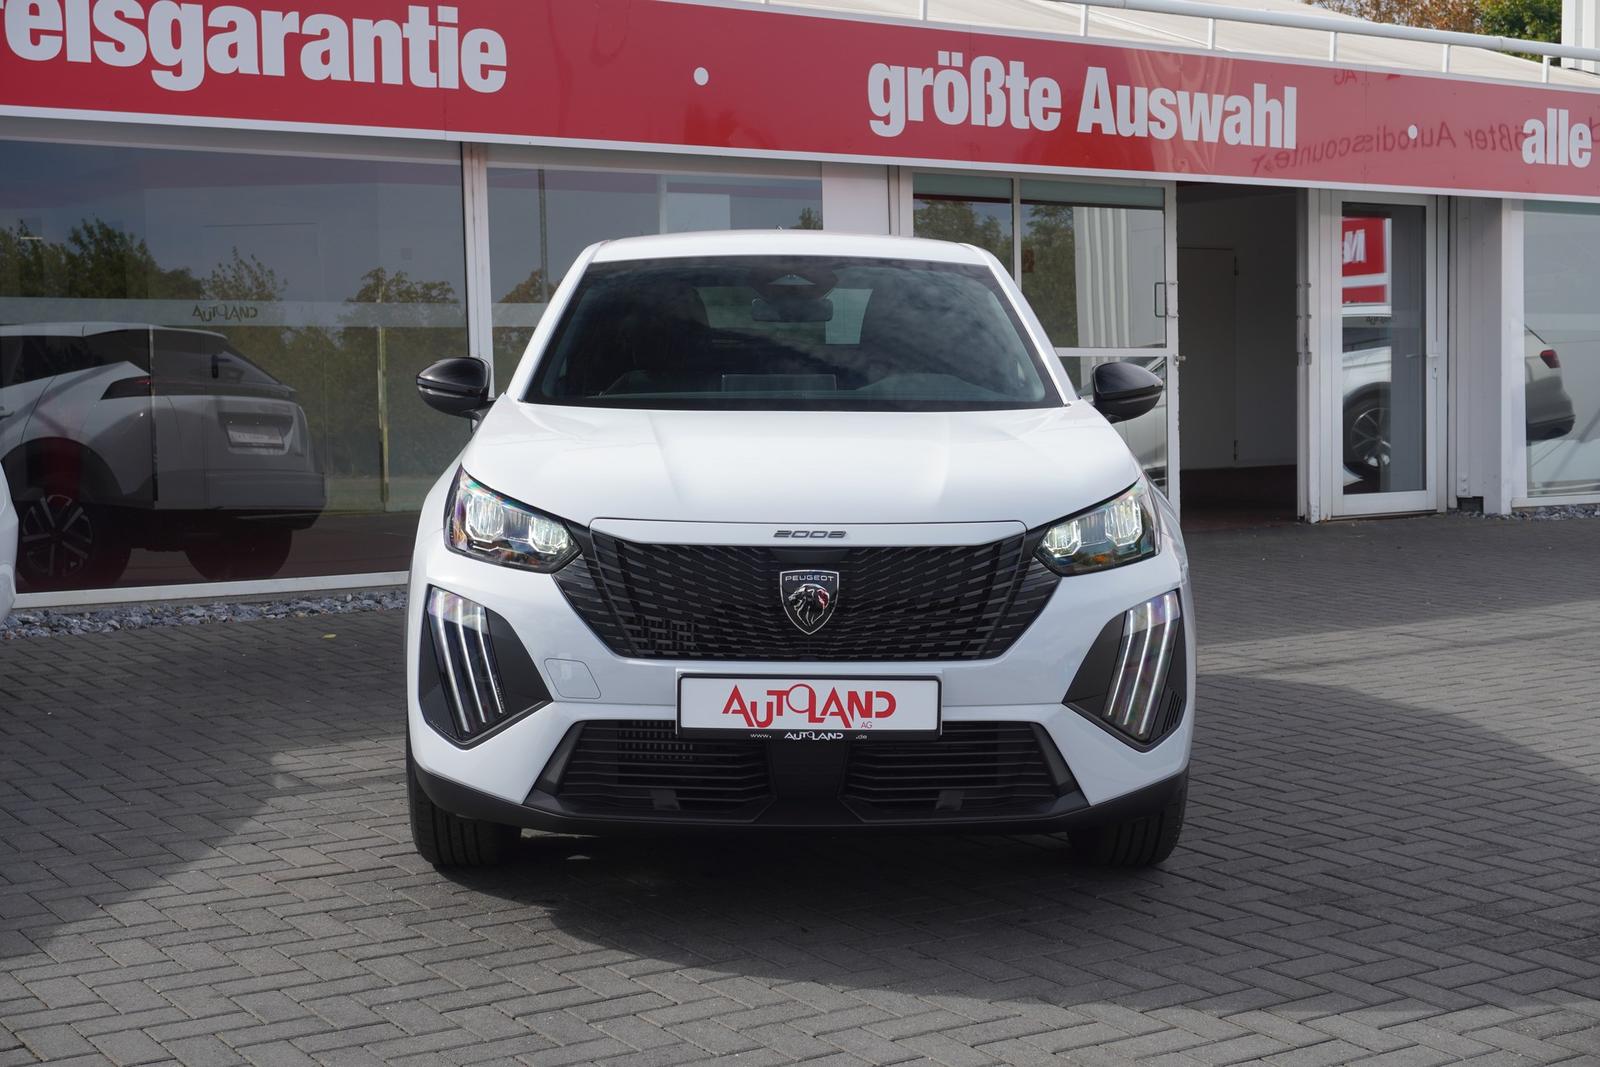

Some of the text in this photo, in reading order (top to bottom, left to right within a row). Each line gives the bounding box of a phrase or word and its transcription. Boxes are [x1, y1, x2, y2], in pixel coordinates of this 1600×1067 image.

[0, 0, 507, 93] eisgarantie
[867, 51, 1298, 150] größte Auswahl
[1521, 108, 1593, 169] alle
[773, 530, 848, 539] 2008
[784, 574, 835, 582] PEUGEOT
[860, 720, 873, 729] AG
